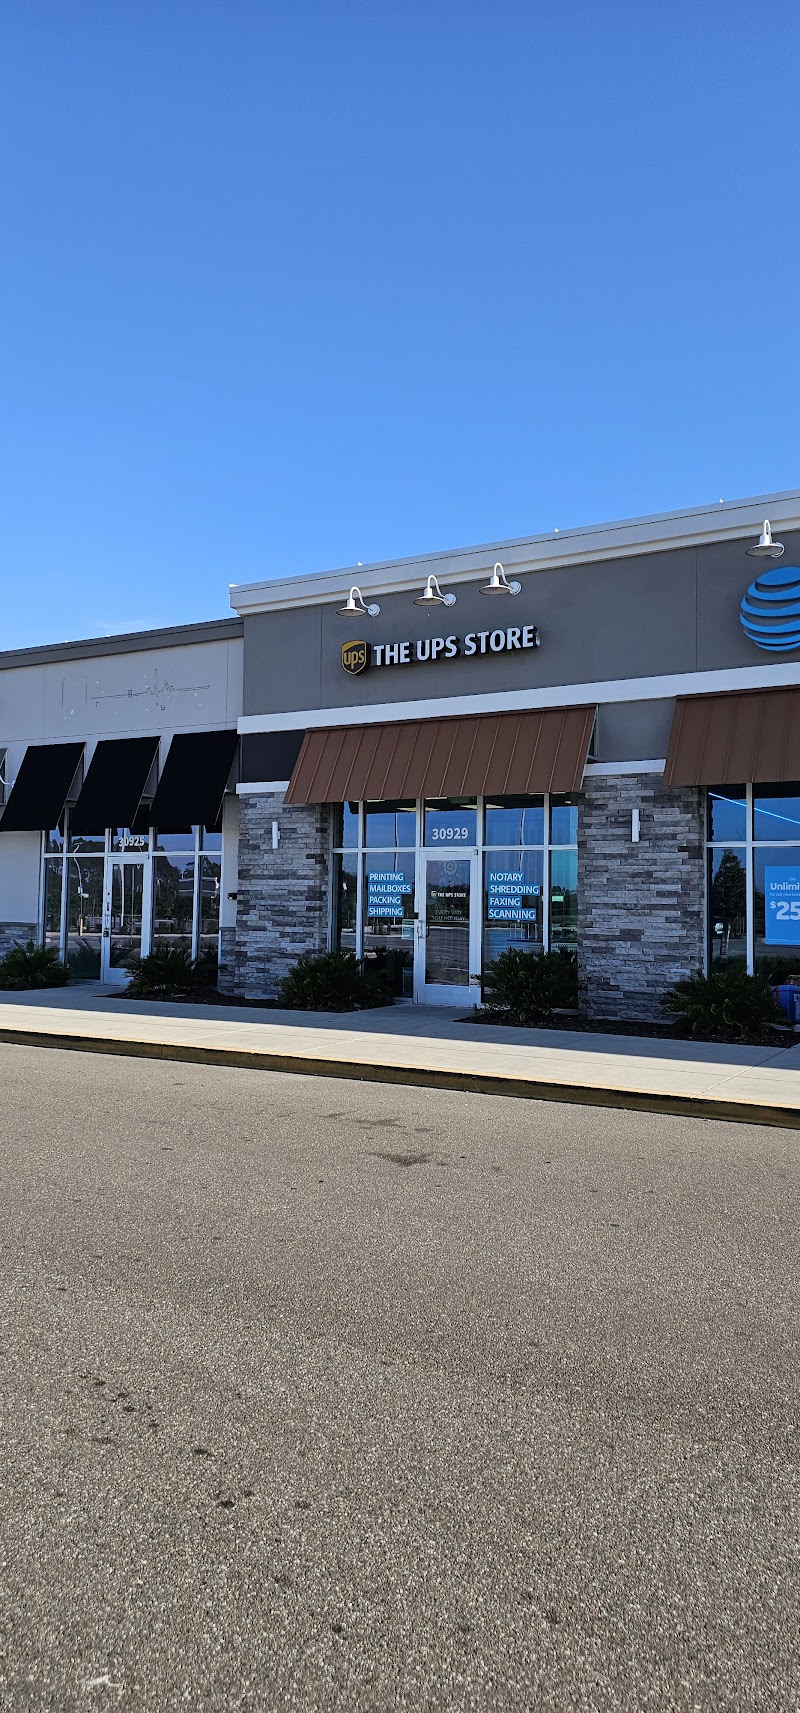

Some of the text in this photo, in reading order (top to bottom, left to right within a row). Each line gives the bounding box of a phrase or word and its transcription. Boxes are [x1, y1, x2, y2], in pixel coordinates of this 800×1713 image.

[374, 625, 534, 666] THE UPS STORE
[431, 827, 469, 840] 30929
[118, 836, 145, 847] 30925
[369, 873, 404, 881] PRINTING
[490, 872, 524, 881] NOTARY
[369, 884, 411, 893] MAILBOXES
[490, 885, 539, 894] SHREDDING
[770, 882, 800, 891] Unlimi
[369, 896, 401, 904] PACKING
[489, 897, 521, 906] FAXING
[368, 907, 403, 916] SHIPPING
[488, 909, 536, 919] SCANNING
[770, 901, 800, 920] $25
